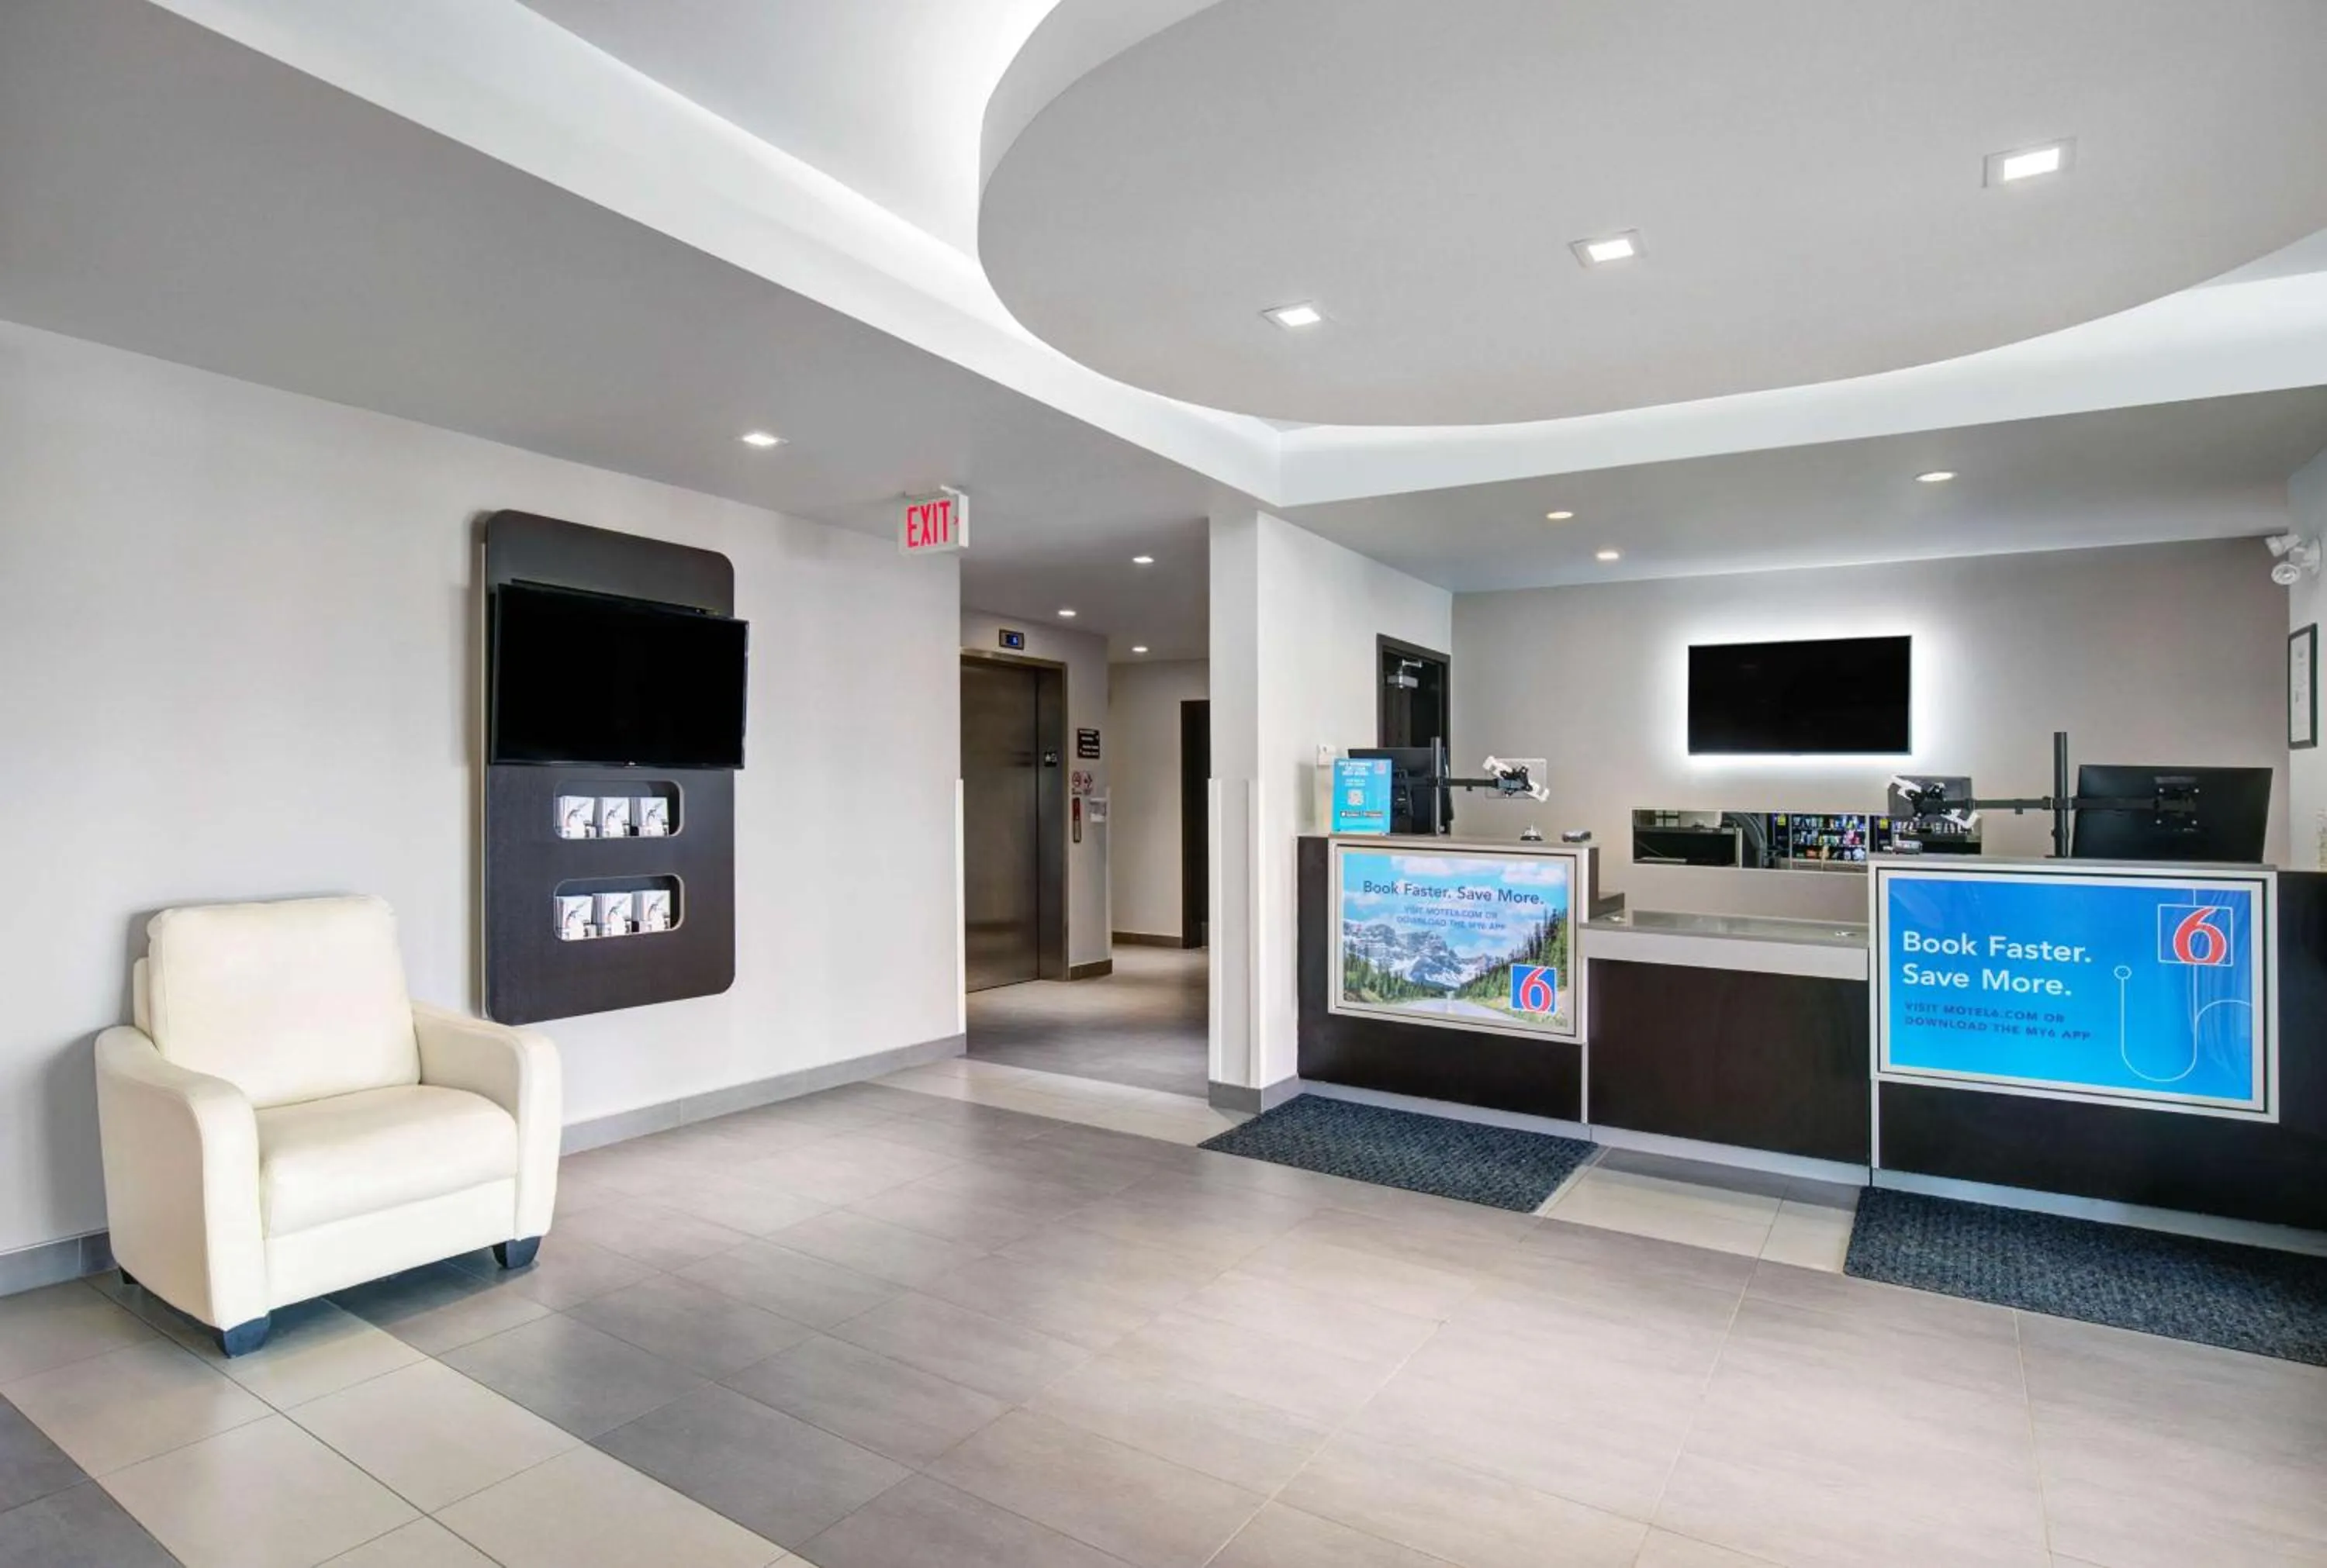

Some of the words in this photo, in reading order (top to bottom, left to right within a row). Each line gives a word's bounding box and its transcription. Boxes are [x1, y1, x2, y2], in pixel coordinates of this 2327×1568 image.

[907, 500, 951, 547] EXIT
[1363, 880, 1399, 895] Book
[1404, 883, 1451, 899] Faster.
[1457, 886, 1492, 902] Save
[1498, 889, 1544, 905] More.
[1903, 931, 1977, 956] Book
[1989, 935, 2092, 963] Faster.
[2173, 906, 2227, 965] 6
[1520, 967, 1553, 1014] 6
[1902, 963, 1970, 988] Save
[1982, 968, 2072, 996] More.
[1904, 1002, 1938, 1014] VISIT
[2043, 1013, 2065, 1024] OR
[1904, 1016, 1987, 1031] DOWNLOAD
[1993, 1023, 2021, 1034] THE
[2061, 1030, 2090, 1041] APP
